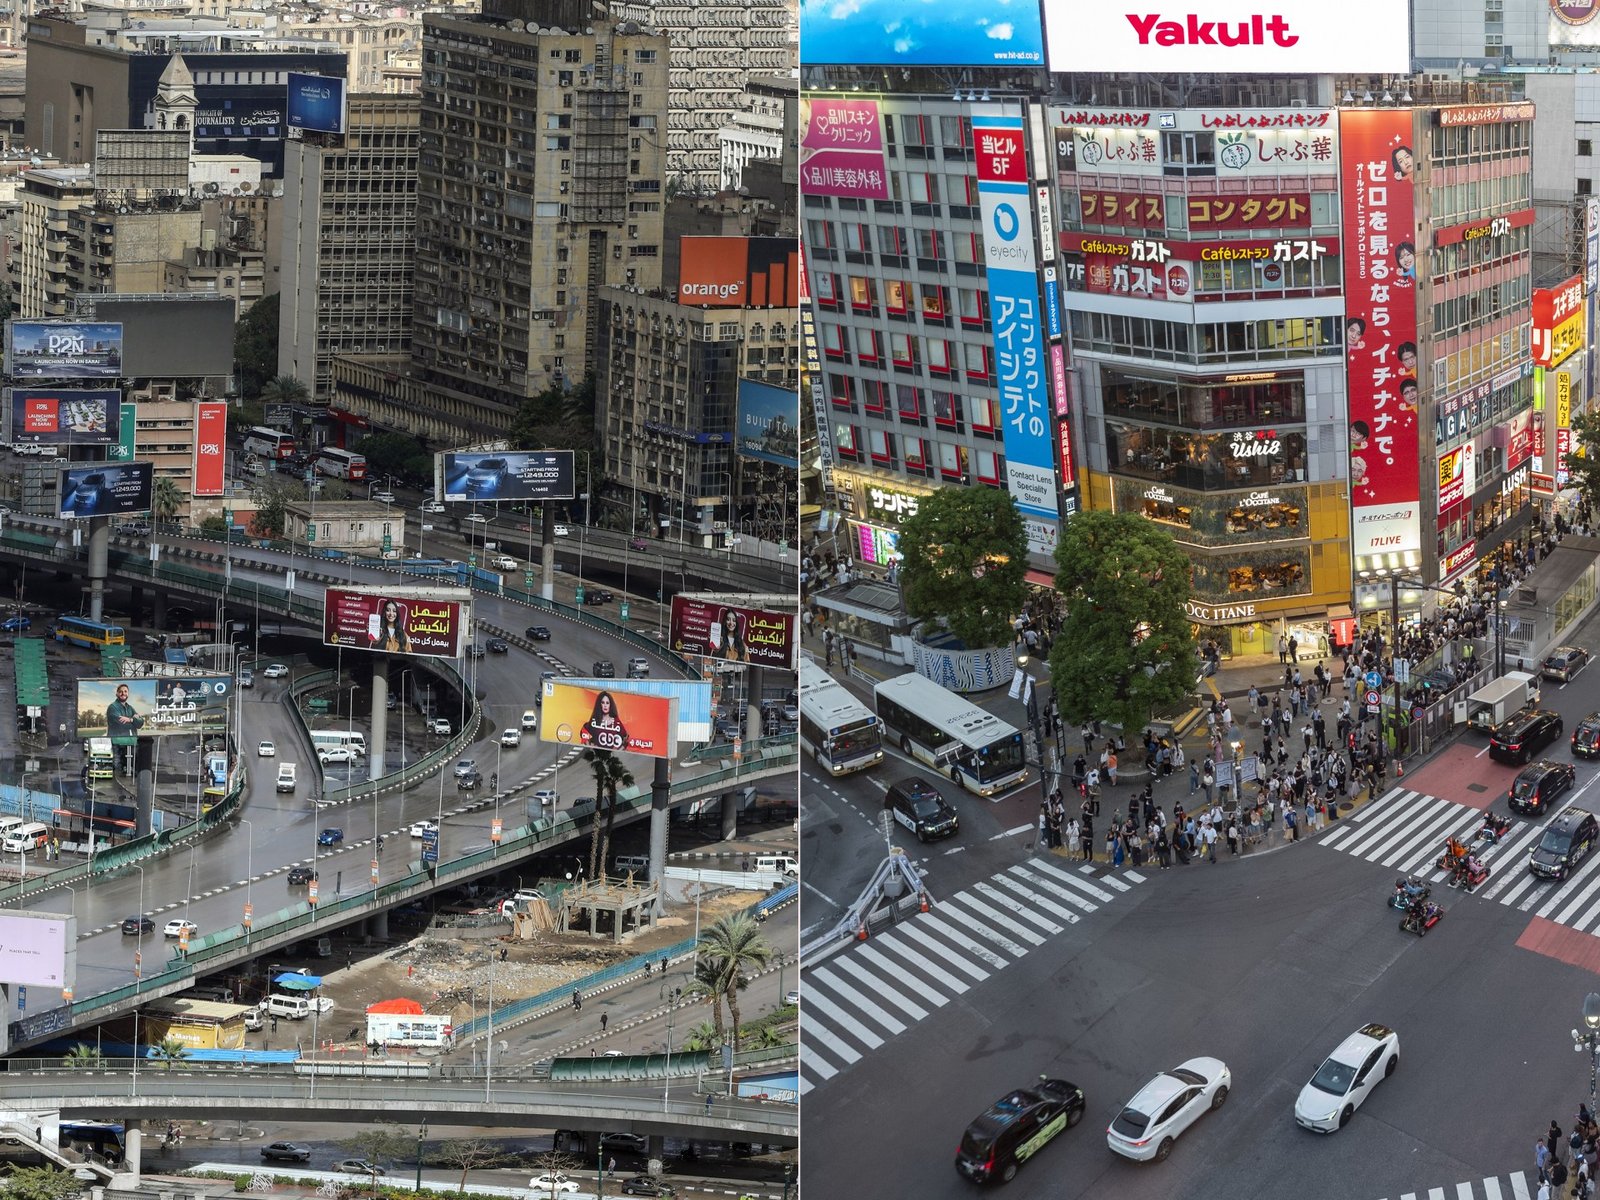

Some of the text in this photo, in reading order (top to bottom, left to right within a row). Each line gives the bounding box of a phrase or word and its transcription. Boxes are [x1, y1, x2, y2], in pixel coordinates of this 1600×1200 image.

[1126, 13, 1299, 48] Yakult
[994, 51, 1040, 61] www.hit-ad.co.jp
[195, 117, 235, 128] JOURNALISTS
[828, 109, 874, 125] 品川スキン
[1060, 110, 1150, 128] しゃぶしゃぶバイキング
[1201, 113, 1330, 128] しゃぶしゃぶバイキング
[831, 127, 871, 143] クリニック
[982, 135, 1016, 155] 当ビル
[1058, 140, 1073, 156] 9F
[1105, 137, 1156, 163] しゃぶ葉
[1258, 135, 1332, 162] しゃぶ葉
[992, 157, 1010, 175] 5F
[812, 166, 882, 190] 品川美容外科
[1081, 194, 1164, 221] プライス
[1190, 197, 1306, 222] コンタクト
[990, 245, 1028, 262] eyecity
[1131, 239, 1171, 263] ガスト
[1273, 240, 1327, 263] ガスト
[1067, 263, 1085, 280] 7F
[1112, 263, 1162, 294] ガスト
[682, 283, 739, 298] orange
[994, 294, 1025, 435] アイシティ
[1018, 298, 1045, 438] コンタクトの
[1559, 374, 1568, 411] 処方せん
[746, 413, 788, 432] BUILT TO
[1230, 440, 1281, 458] Ushi8
[1010, 469, 1053, 485] Contact Lens
[1441, 458, 1452, 483] 薬
[1016, 481, 1048, 495] Speciality
[1502, 466, 1527, 497] LUSH
[1024, 493, 1042, 504] Store
[411, 604, 450, 619] أسهل
[409, 619, 450, 634] أبلكيشن
[749, 615, 785, 630] أسهل
[748, 630, 785, 648] أبلكيشن
